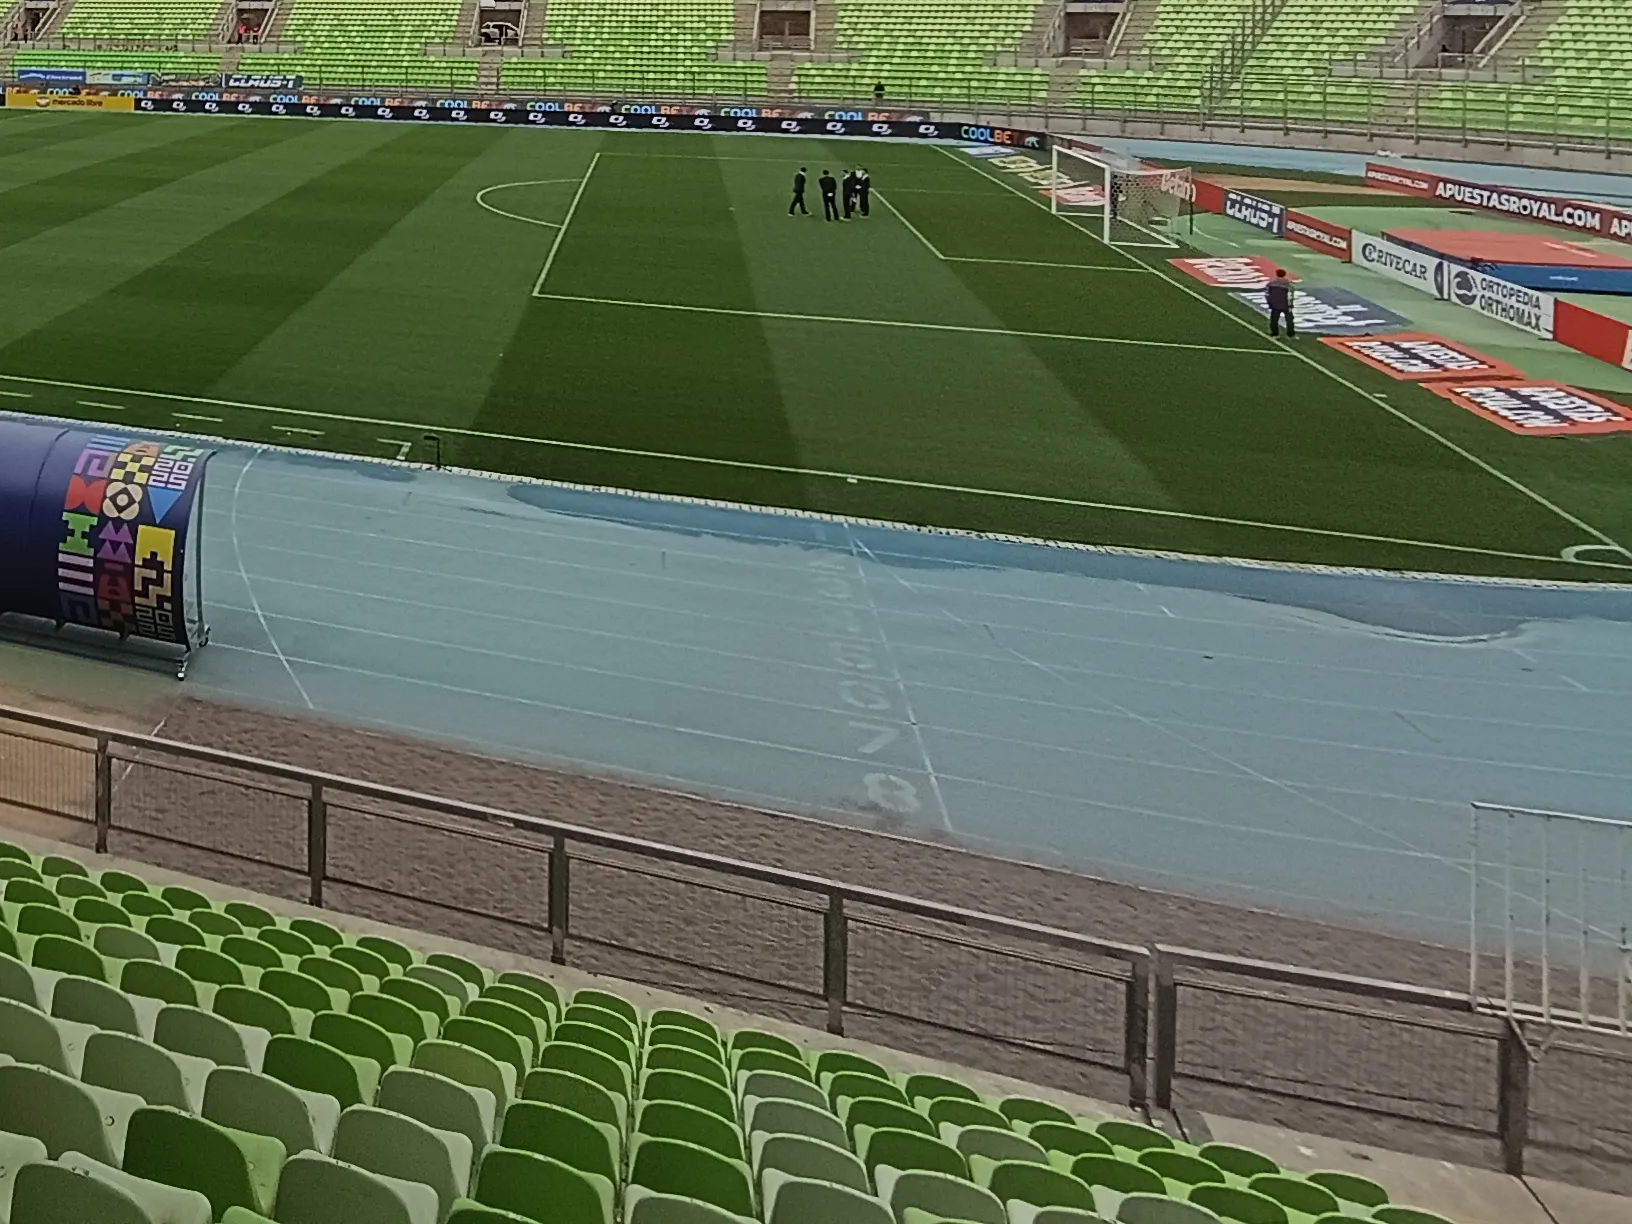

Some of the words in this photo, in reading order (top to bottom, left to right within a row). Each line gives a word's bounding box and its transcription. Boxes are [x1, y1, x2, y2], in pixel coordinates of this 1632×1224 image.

[1435, 181, 1601, 230] APUESTASROYAL.COM
[1479, 294, 1542, 333] ORTHOMAX
[1480, 277, 1541, 311] ORTOPEDIA
